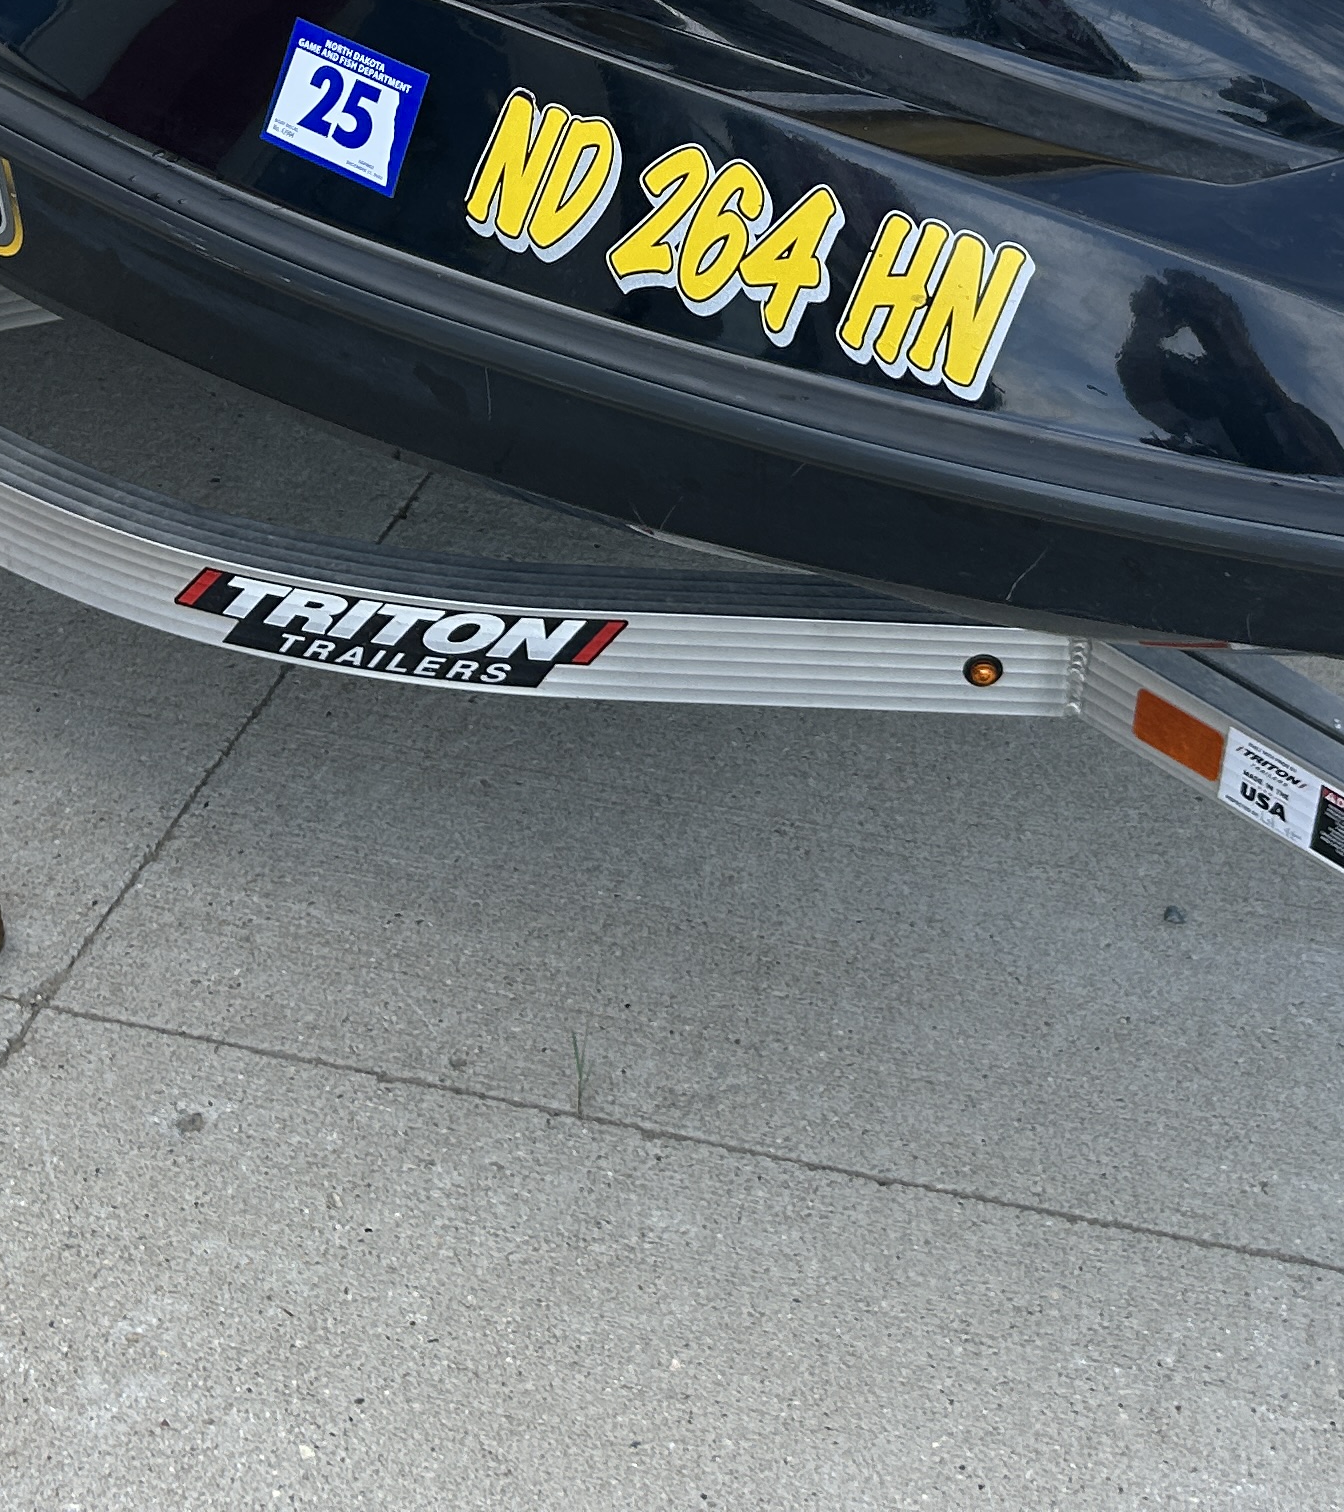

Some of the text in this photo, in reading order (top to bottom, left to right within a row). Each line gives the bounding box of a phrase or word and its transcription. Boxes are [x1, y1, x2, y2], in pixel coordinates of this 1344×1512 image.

[298, 38, 413, 94] GAME AND FISH DEPARTMENT
[325, 39, 386, 73] NORTH DAKOTA
[296, 65, 382, 150] 25
[465, 87, 1037, 401] ND 264 HN
[222, 575, 589, 662] TRITON
[279, 632, 513, 684] TRAILERS
[1243, 748, 1302, 786] TRITON
[1240, 781, 1287, 823] USA
